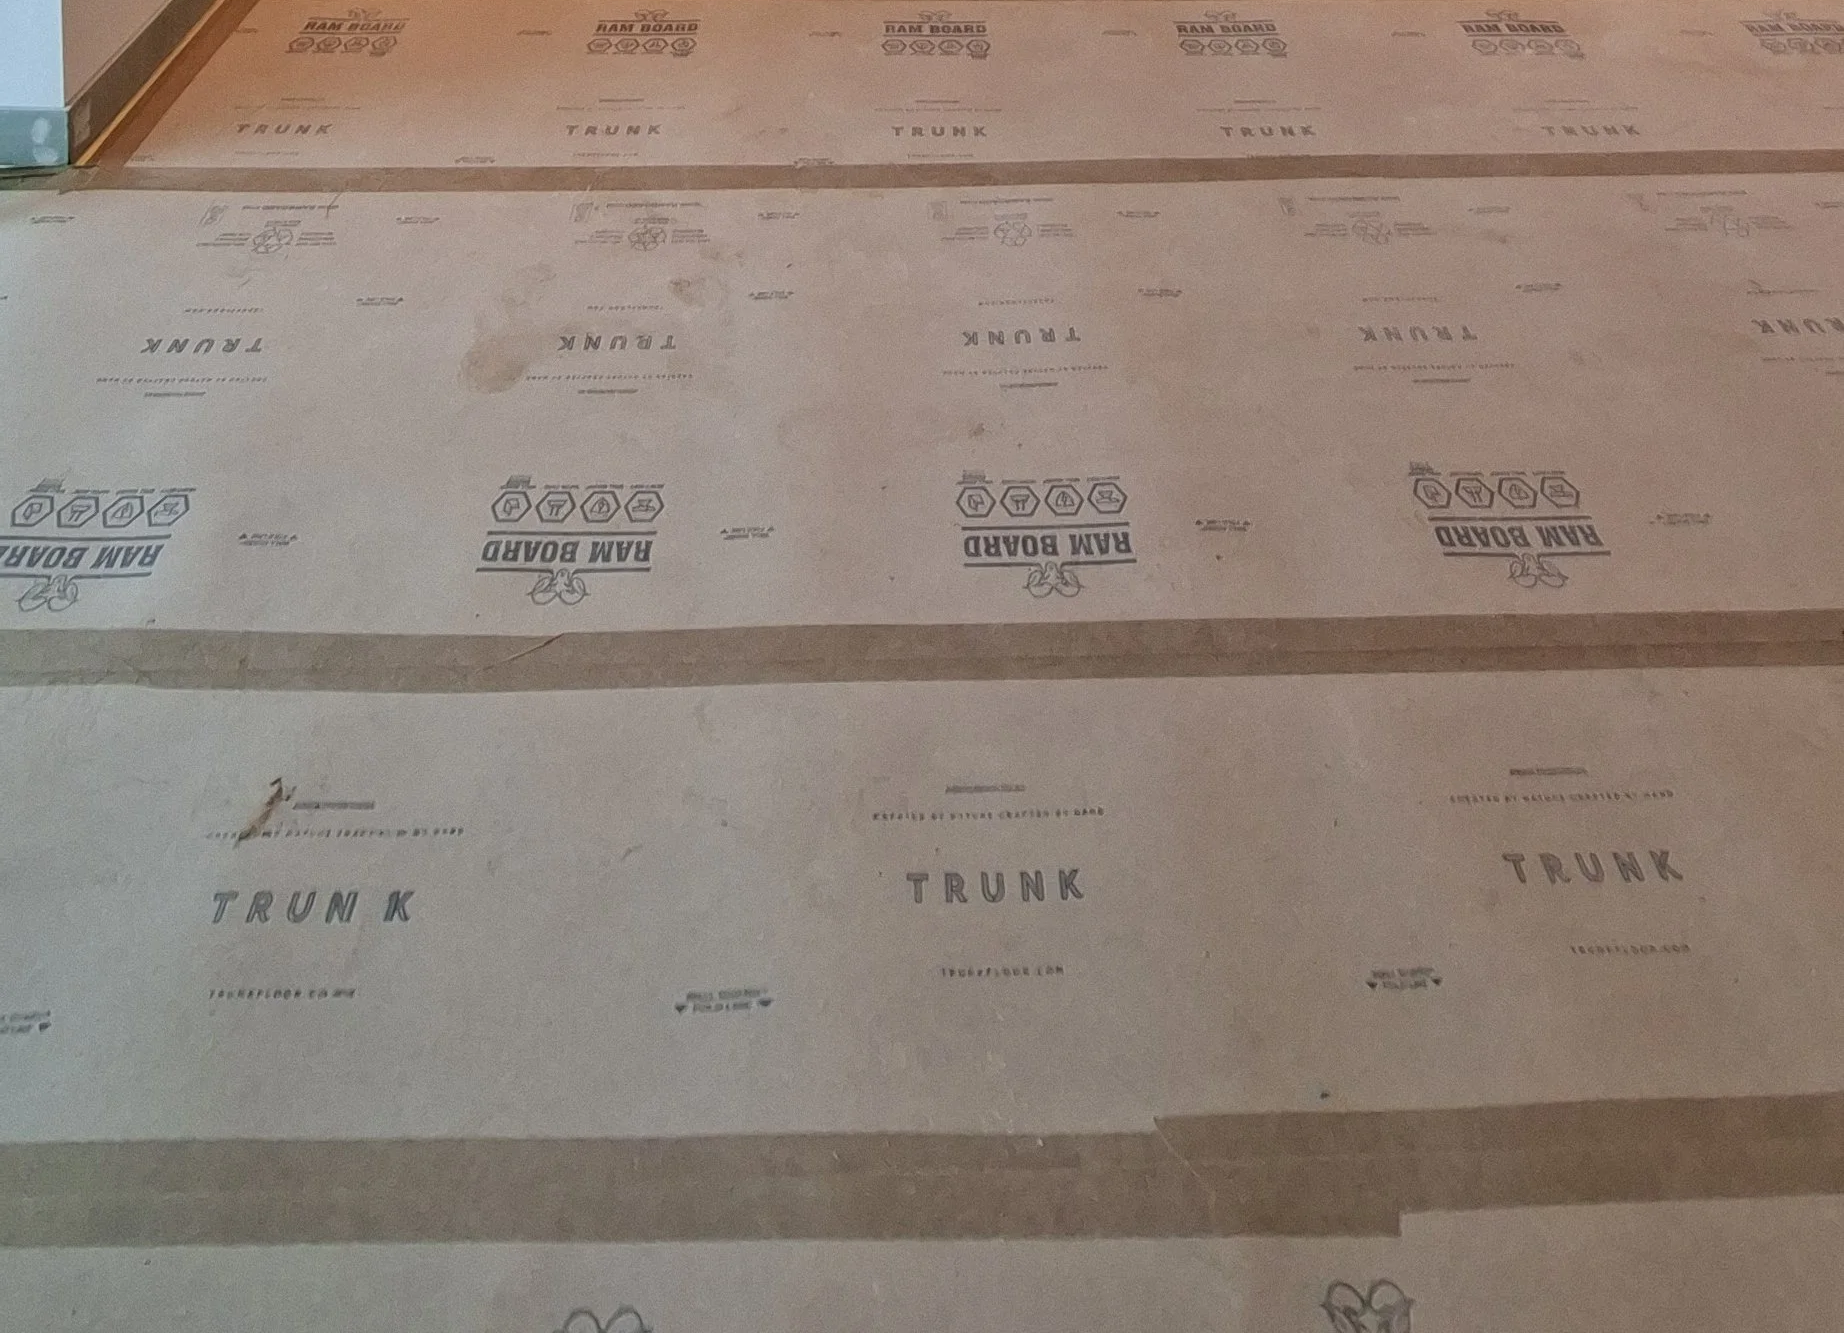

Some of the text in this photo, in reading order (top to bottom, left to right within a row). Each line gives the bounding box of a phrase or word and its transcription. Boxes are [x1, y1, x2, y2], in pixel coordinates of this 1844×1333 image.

[140, 337, 264, 354] TRUNK
[557, 334, 677, 352] TRUNK
[961, 326, 1081, 347] TRUNK
[963, 533, 1133, 559] RAM BOARD
[1433, 522, 1606, 550] RAM BOARD
[90, 543, 165, 570] RAM
[480, 539, 653, 565] RAM BOARD
[1503, 849, 1684, 883] TRUNK
[906, 869, 1085, 903] TRUNK
